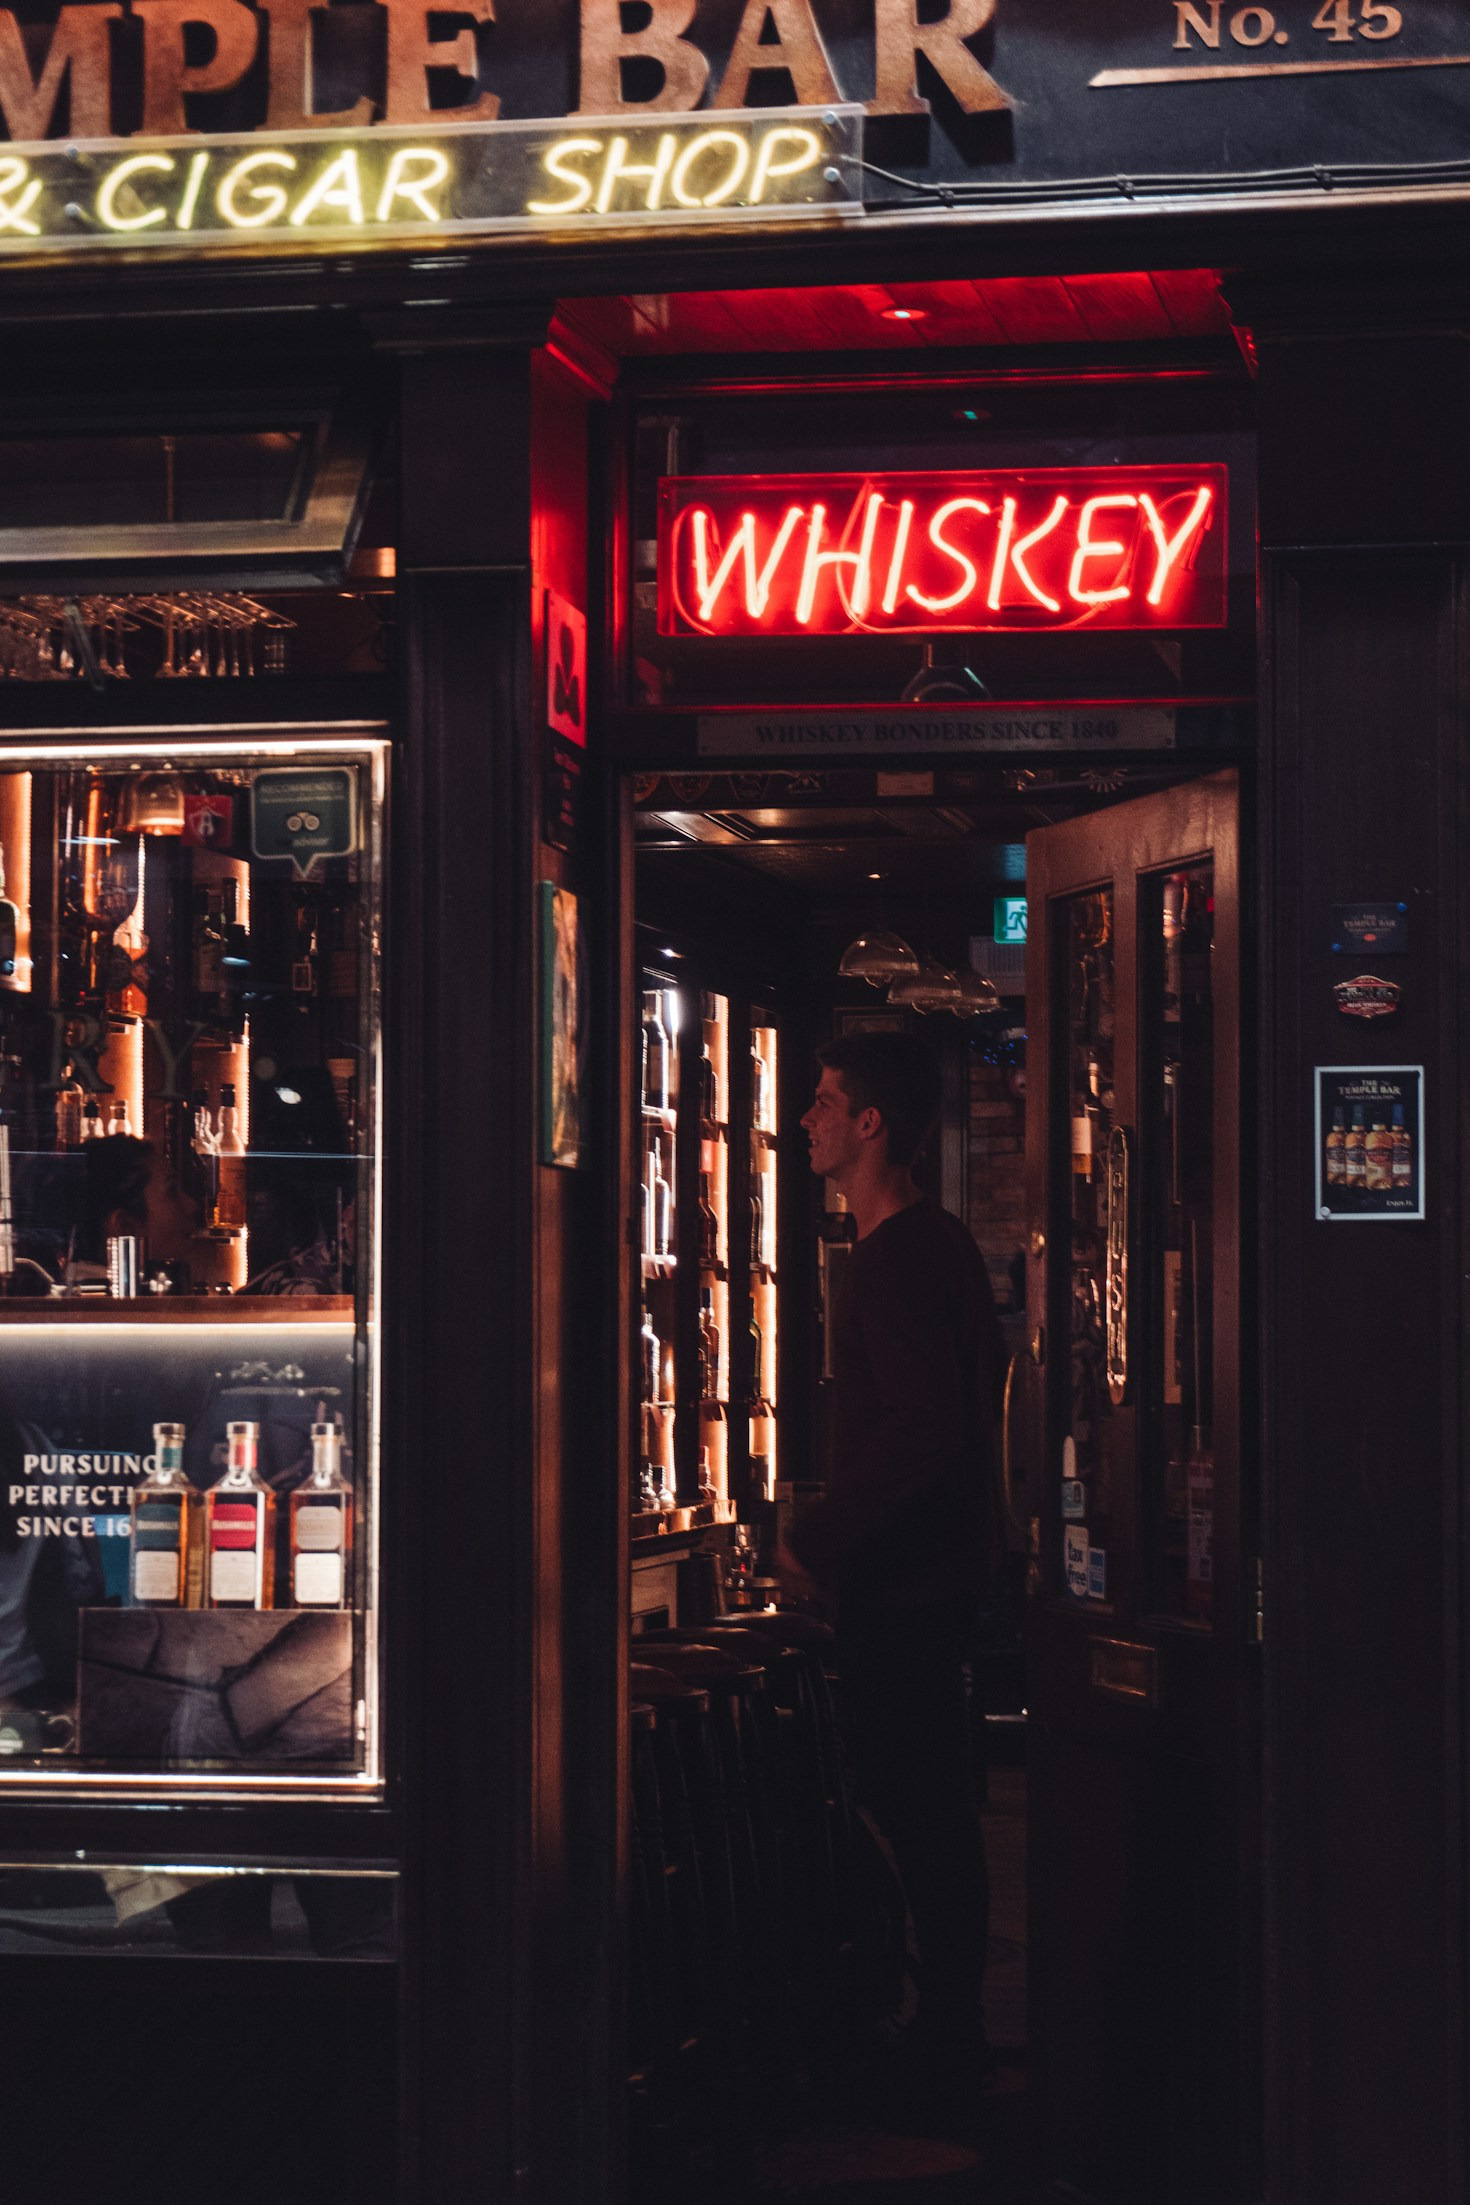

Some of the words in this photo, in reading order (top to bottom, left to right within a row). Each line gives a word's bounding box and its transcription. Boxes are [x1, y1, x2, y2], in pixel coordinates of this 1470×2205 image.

[1172, 0, 1289, 48] No.
[1311, 0, 1402, 41] 45
[566, 0, 1015, 116] BAR
[97, 147, 451, 231] CIGAR
[526, 130, 822, 214] SHOP
[691, 486, 1214, 625] WHISKEY
[755, 724, 870, 744] WHISKEY
[873, 722, 985, 742] BONDERS
[991, 719, 1062, 740] SINCE
[1070, 718, 1118, 738] 1840
[1337, 1085, 1378, 1095] TEMPLE
[1379, 1085, 1402, 1095] BAR
[16, 1516, 96, 1537] SINCE
